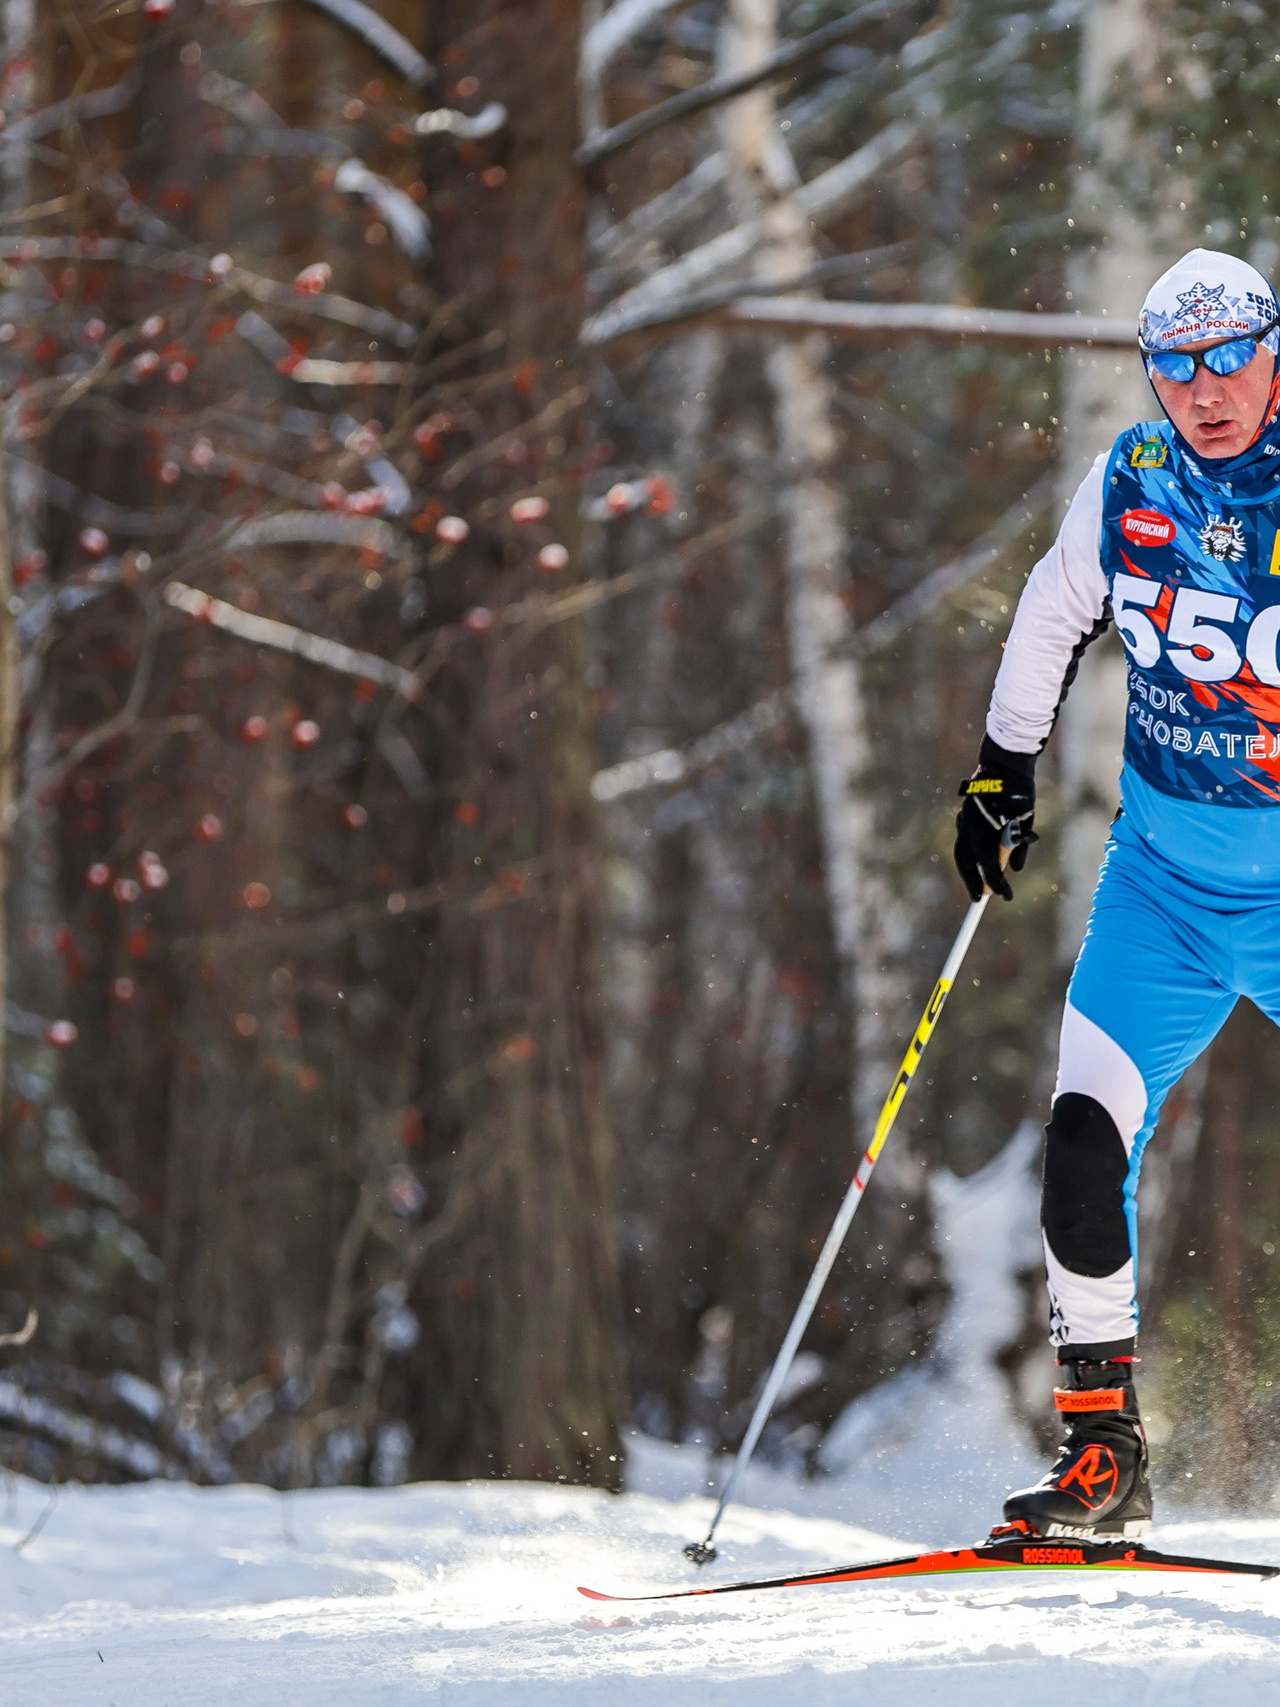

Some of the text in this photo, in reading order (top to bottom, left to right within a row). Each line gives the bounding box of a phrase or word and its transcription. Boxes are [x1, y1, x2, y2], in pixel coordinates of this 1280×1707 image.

[1162, 320, 1249, 342] ЛЫЖНЯ РОССИИ
[1125, 518, 1170, 539] КУРГАНСКИЙ
[1022, 1547, 1087, 1565] ROSSIGNOL
